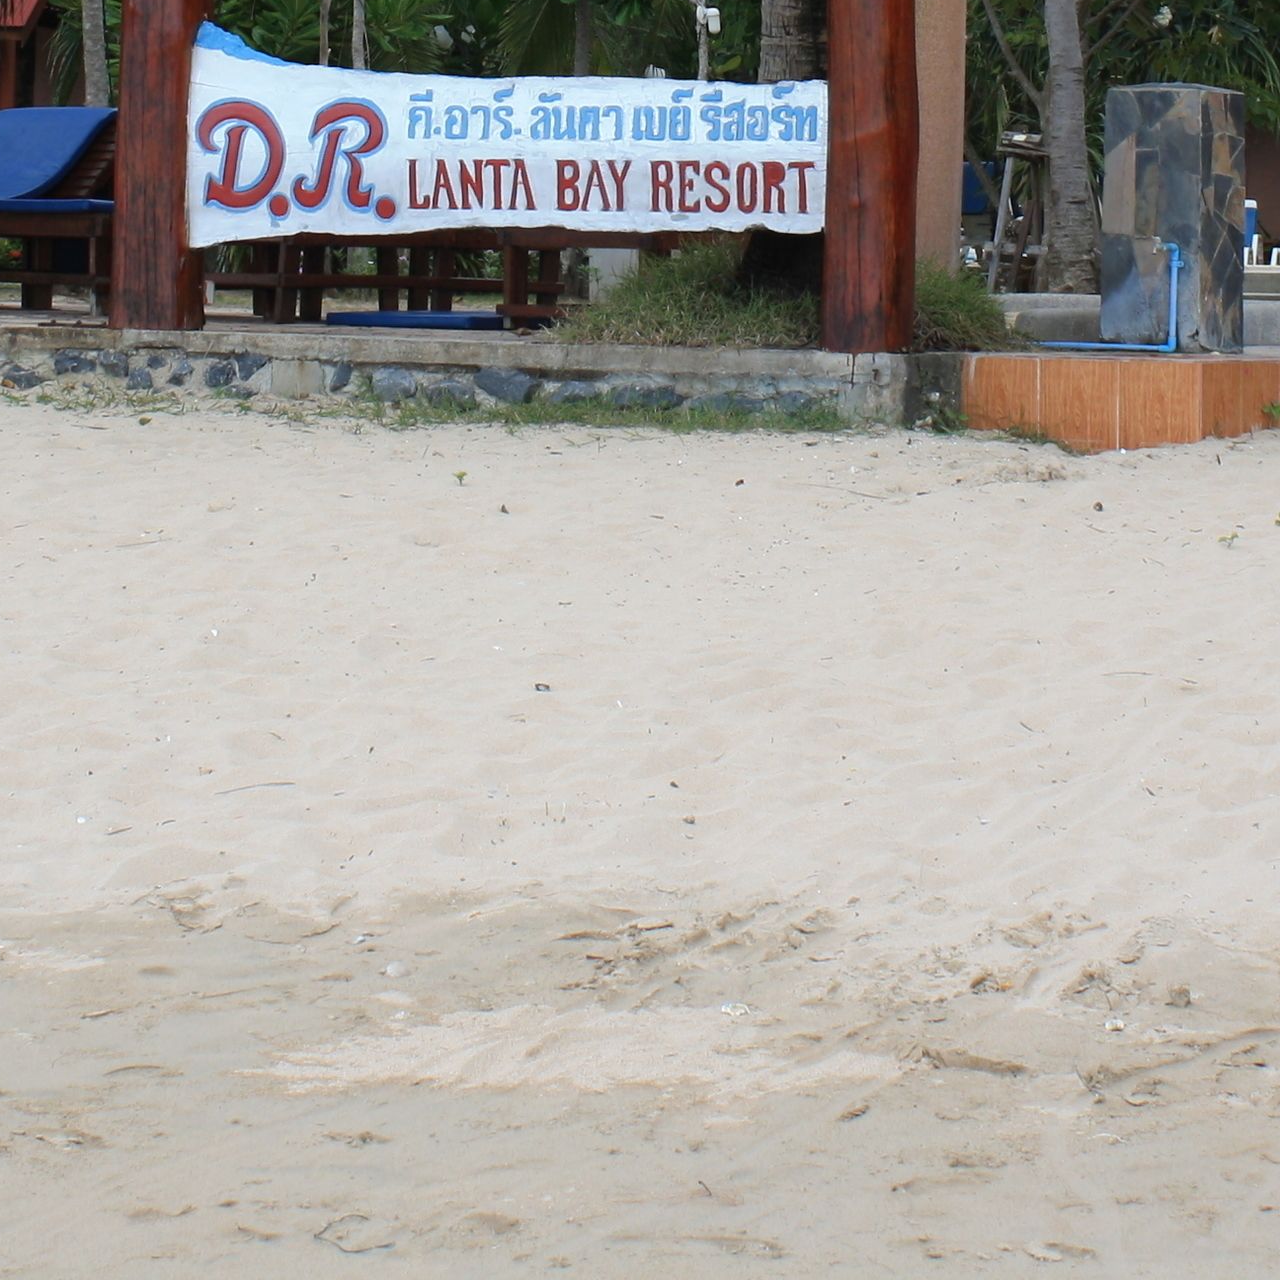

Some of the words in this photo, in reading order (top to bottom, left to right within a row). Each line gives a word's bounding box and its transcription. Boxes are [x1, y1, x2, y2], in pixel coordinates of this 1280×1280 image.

[195, 97, 398, 222] D.R.
[407, 158, 537, 211] LANTA
[555, 159, 632, 213] BAY
[649, 160, 817, 215] RESORT
